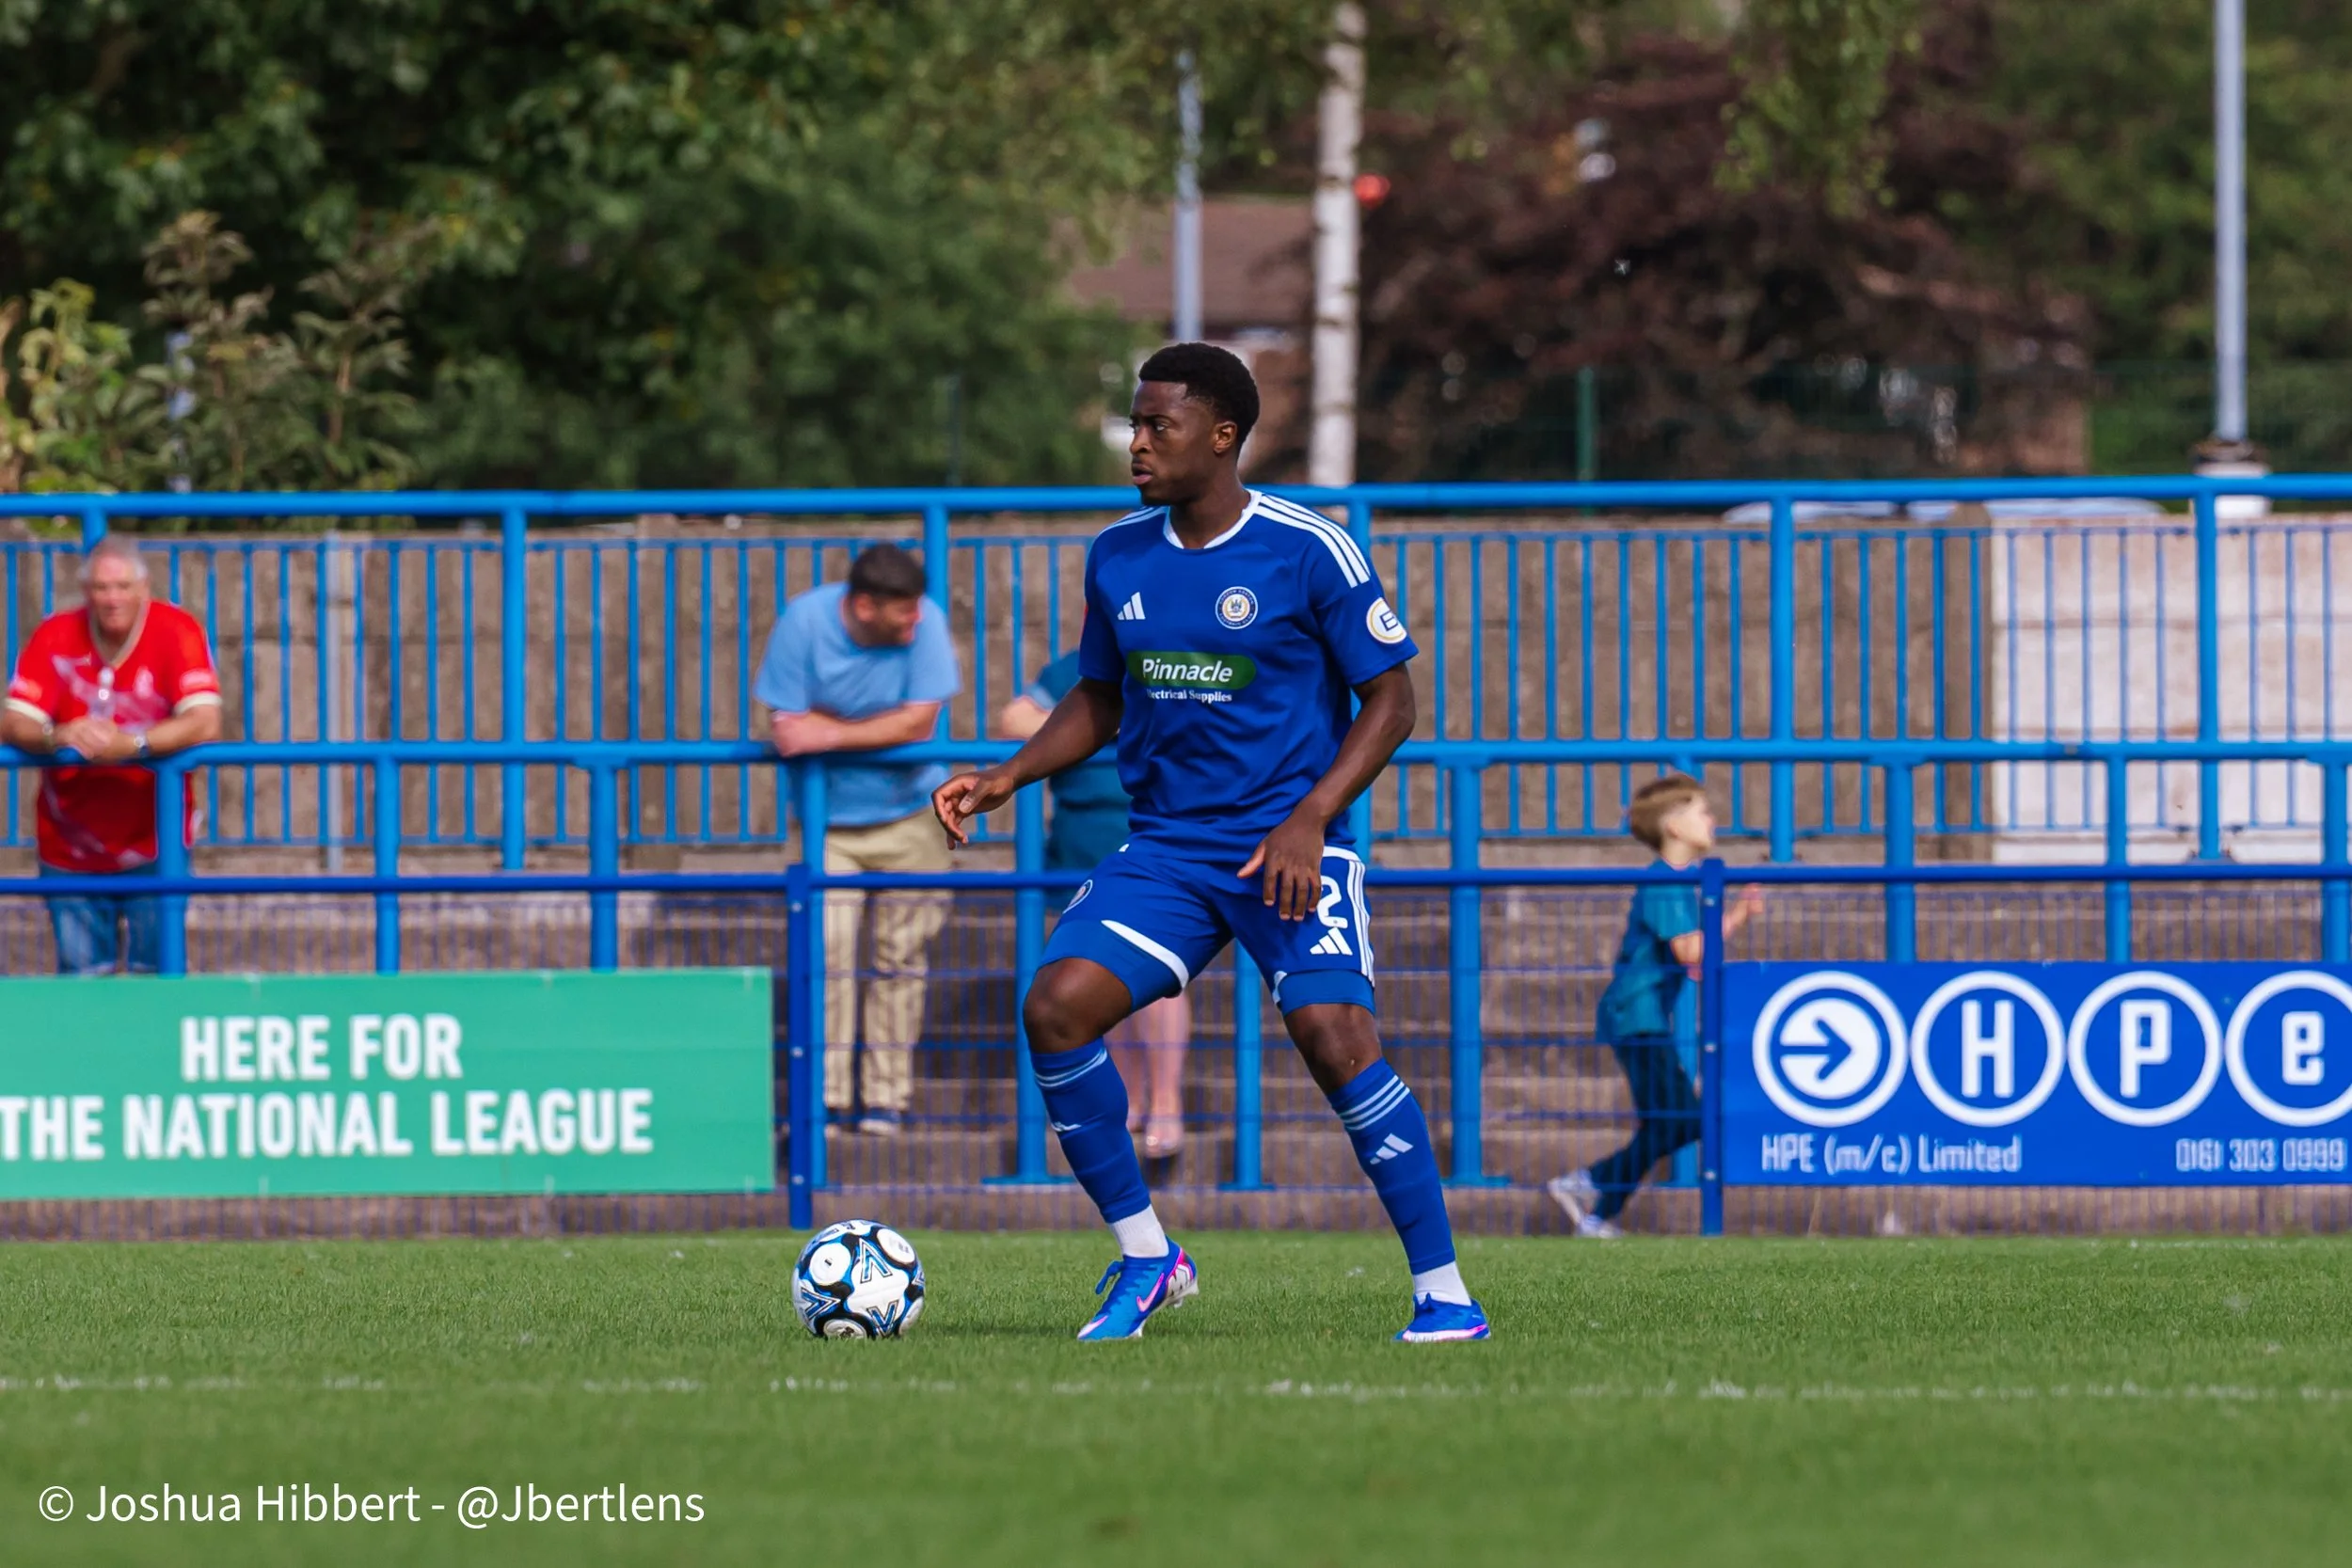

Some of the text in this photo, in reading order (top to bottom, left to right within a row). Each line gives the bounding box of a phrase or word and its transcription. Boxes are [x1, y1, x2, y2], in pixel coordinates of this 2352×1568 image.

[1142, 657, 1233, 683] Pinnacle
[1146, 689, 1233, 704] lectrical Supplies
[1316, 874, 1348, 929] 2
[180, 1013, 464, 1083] HERE FOR
[0, 1087, 654, 1162] THE NATIONAL LEAGUE
[1761, 1132, 2022, 1176] HPE (m/c) Limited
[2175, 1137, 2347, 1173] 0161 303 0999
